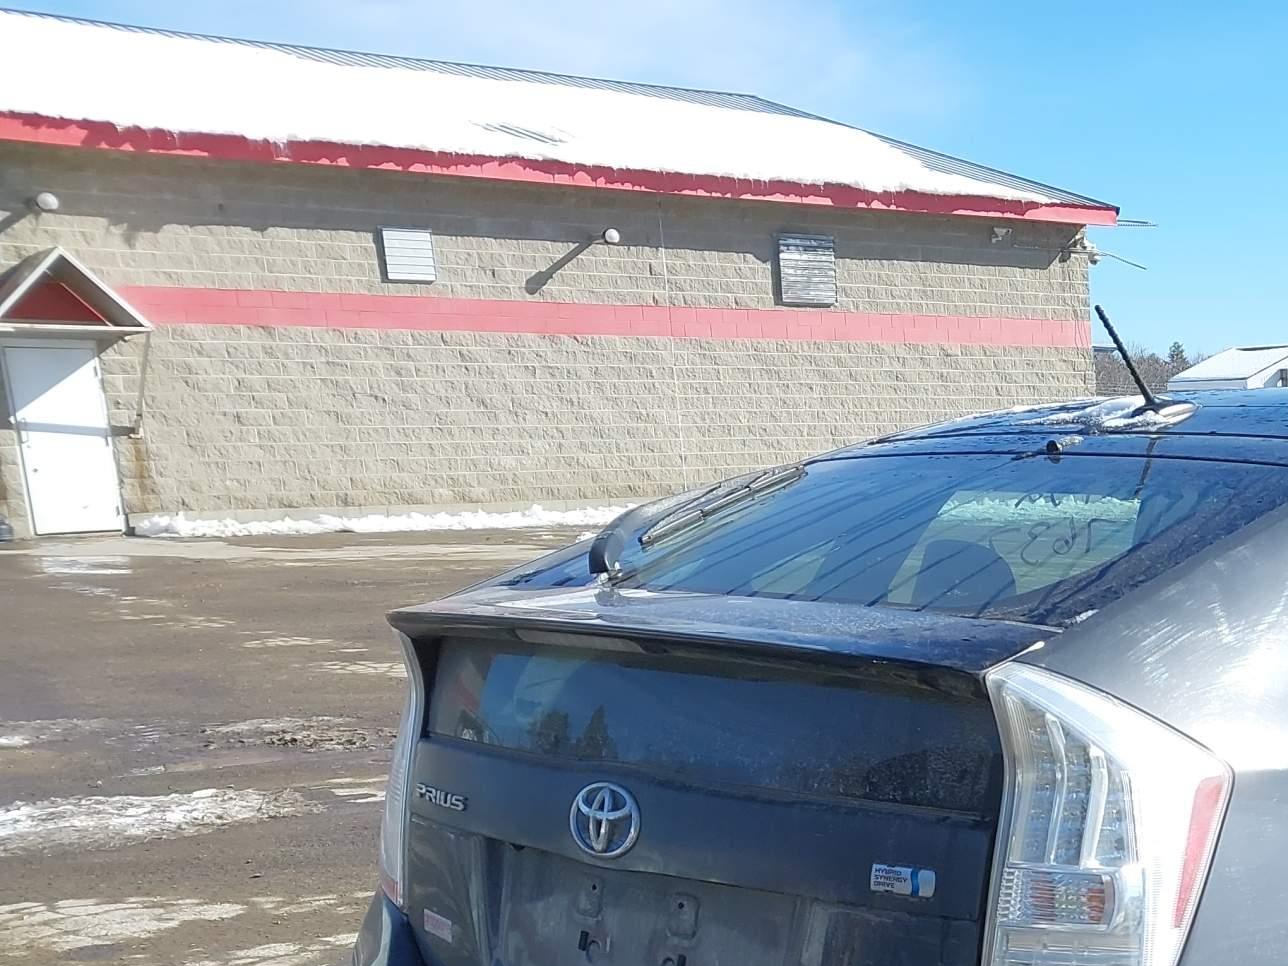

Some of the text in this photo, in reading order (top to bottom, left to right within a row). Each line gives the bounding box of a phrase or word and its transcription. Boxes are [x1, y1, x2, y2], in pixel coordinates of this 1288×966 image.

[416, 782, 465, 811] PRIUS
[873, 874, 908, 883] SYNERGY
[873, 881, 895, 889] DRIVE
